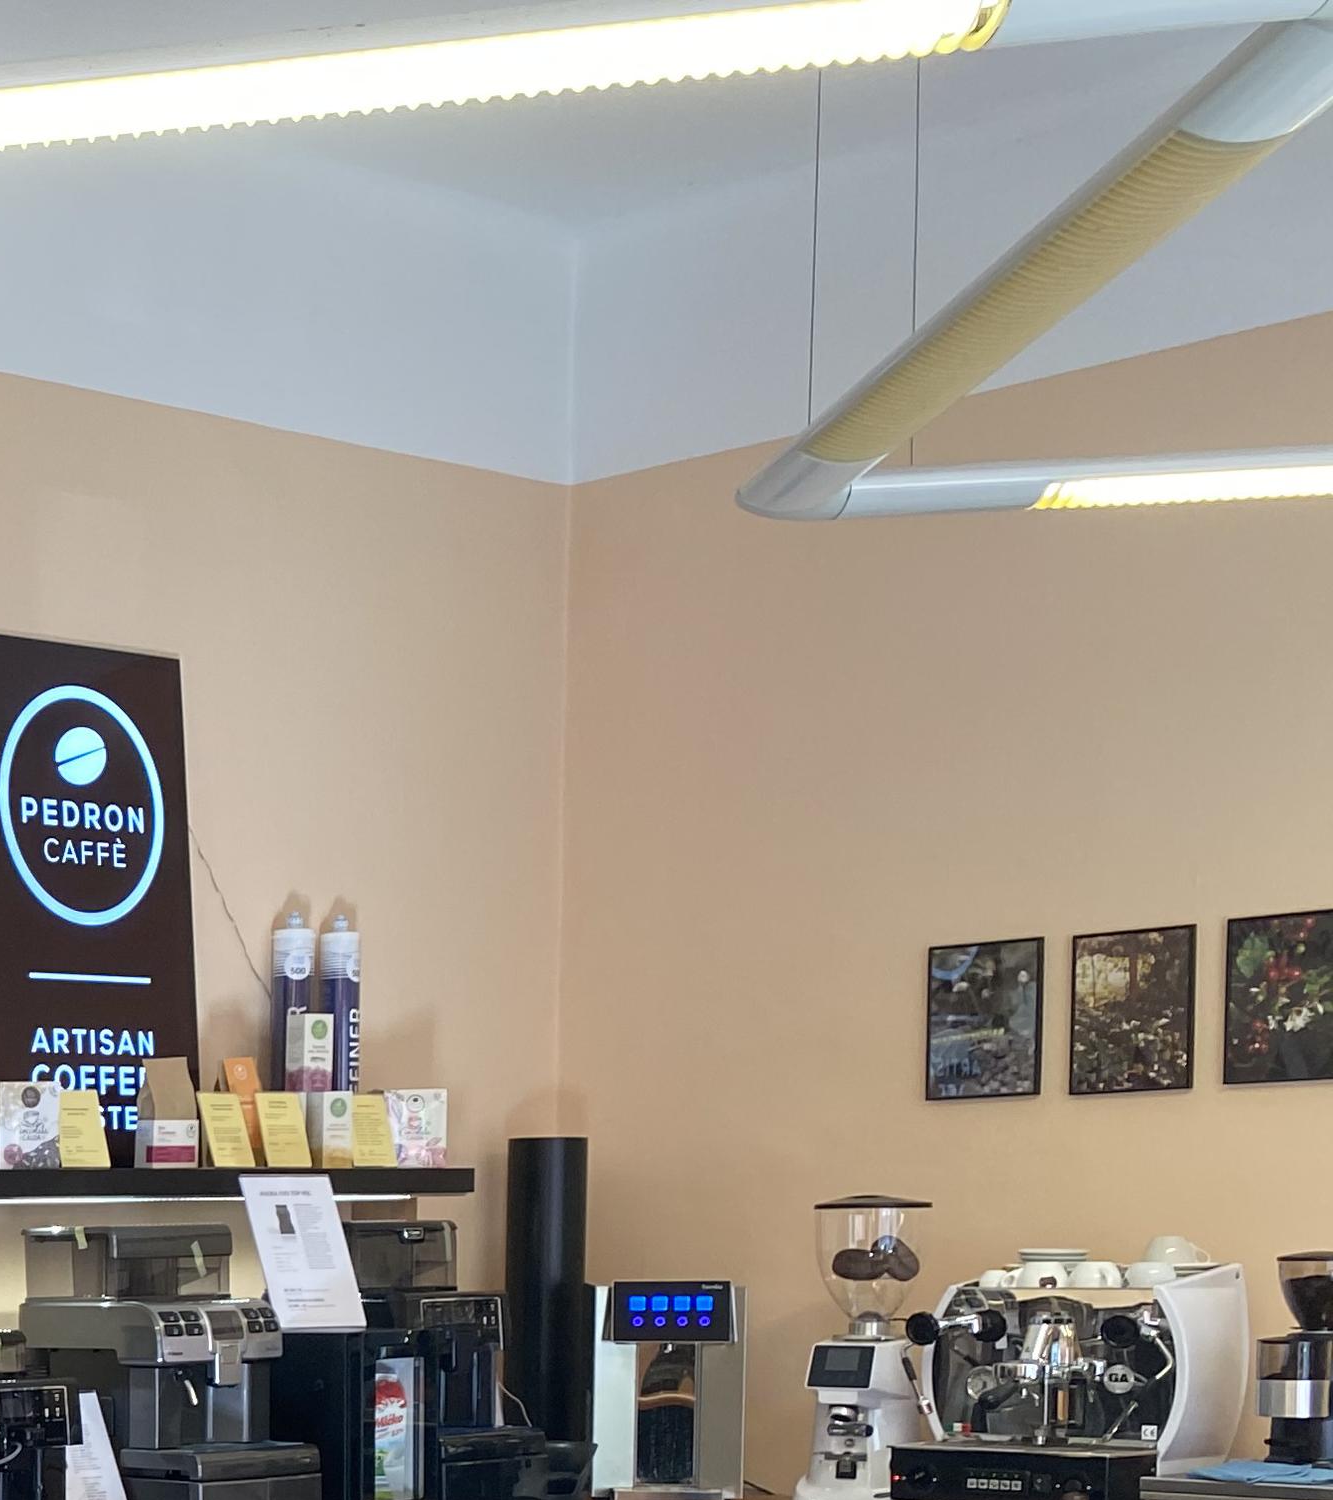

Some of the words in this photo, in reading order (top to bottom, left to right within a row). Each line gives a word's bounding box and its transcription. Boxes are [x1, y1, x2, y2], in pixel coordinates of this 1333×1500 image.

[20, 795, 146, 835] PEDRON
[42, 836, 127, 868] CAFFÈ
[31, 1027, 156, 1057] ARTISAN
[31, 1063, 147, 1097] COFFE
